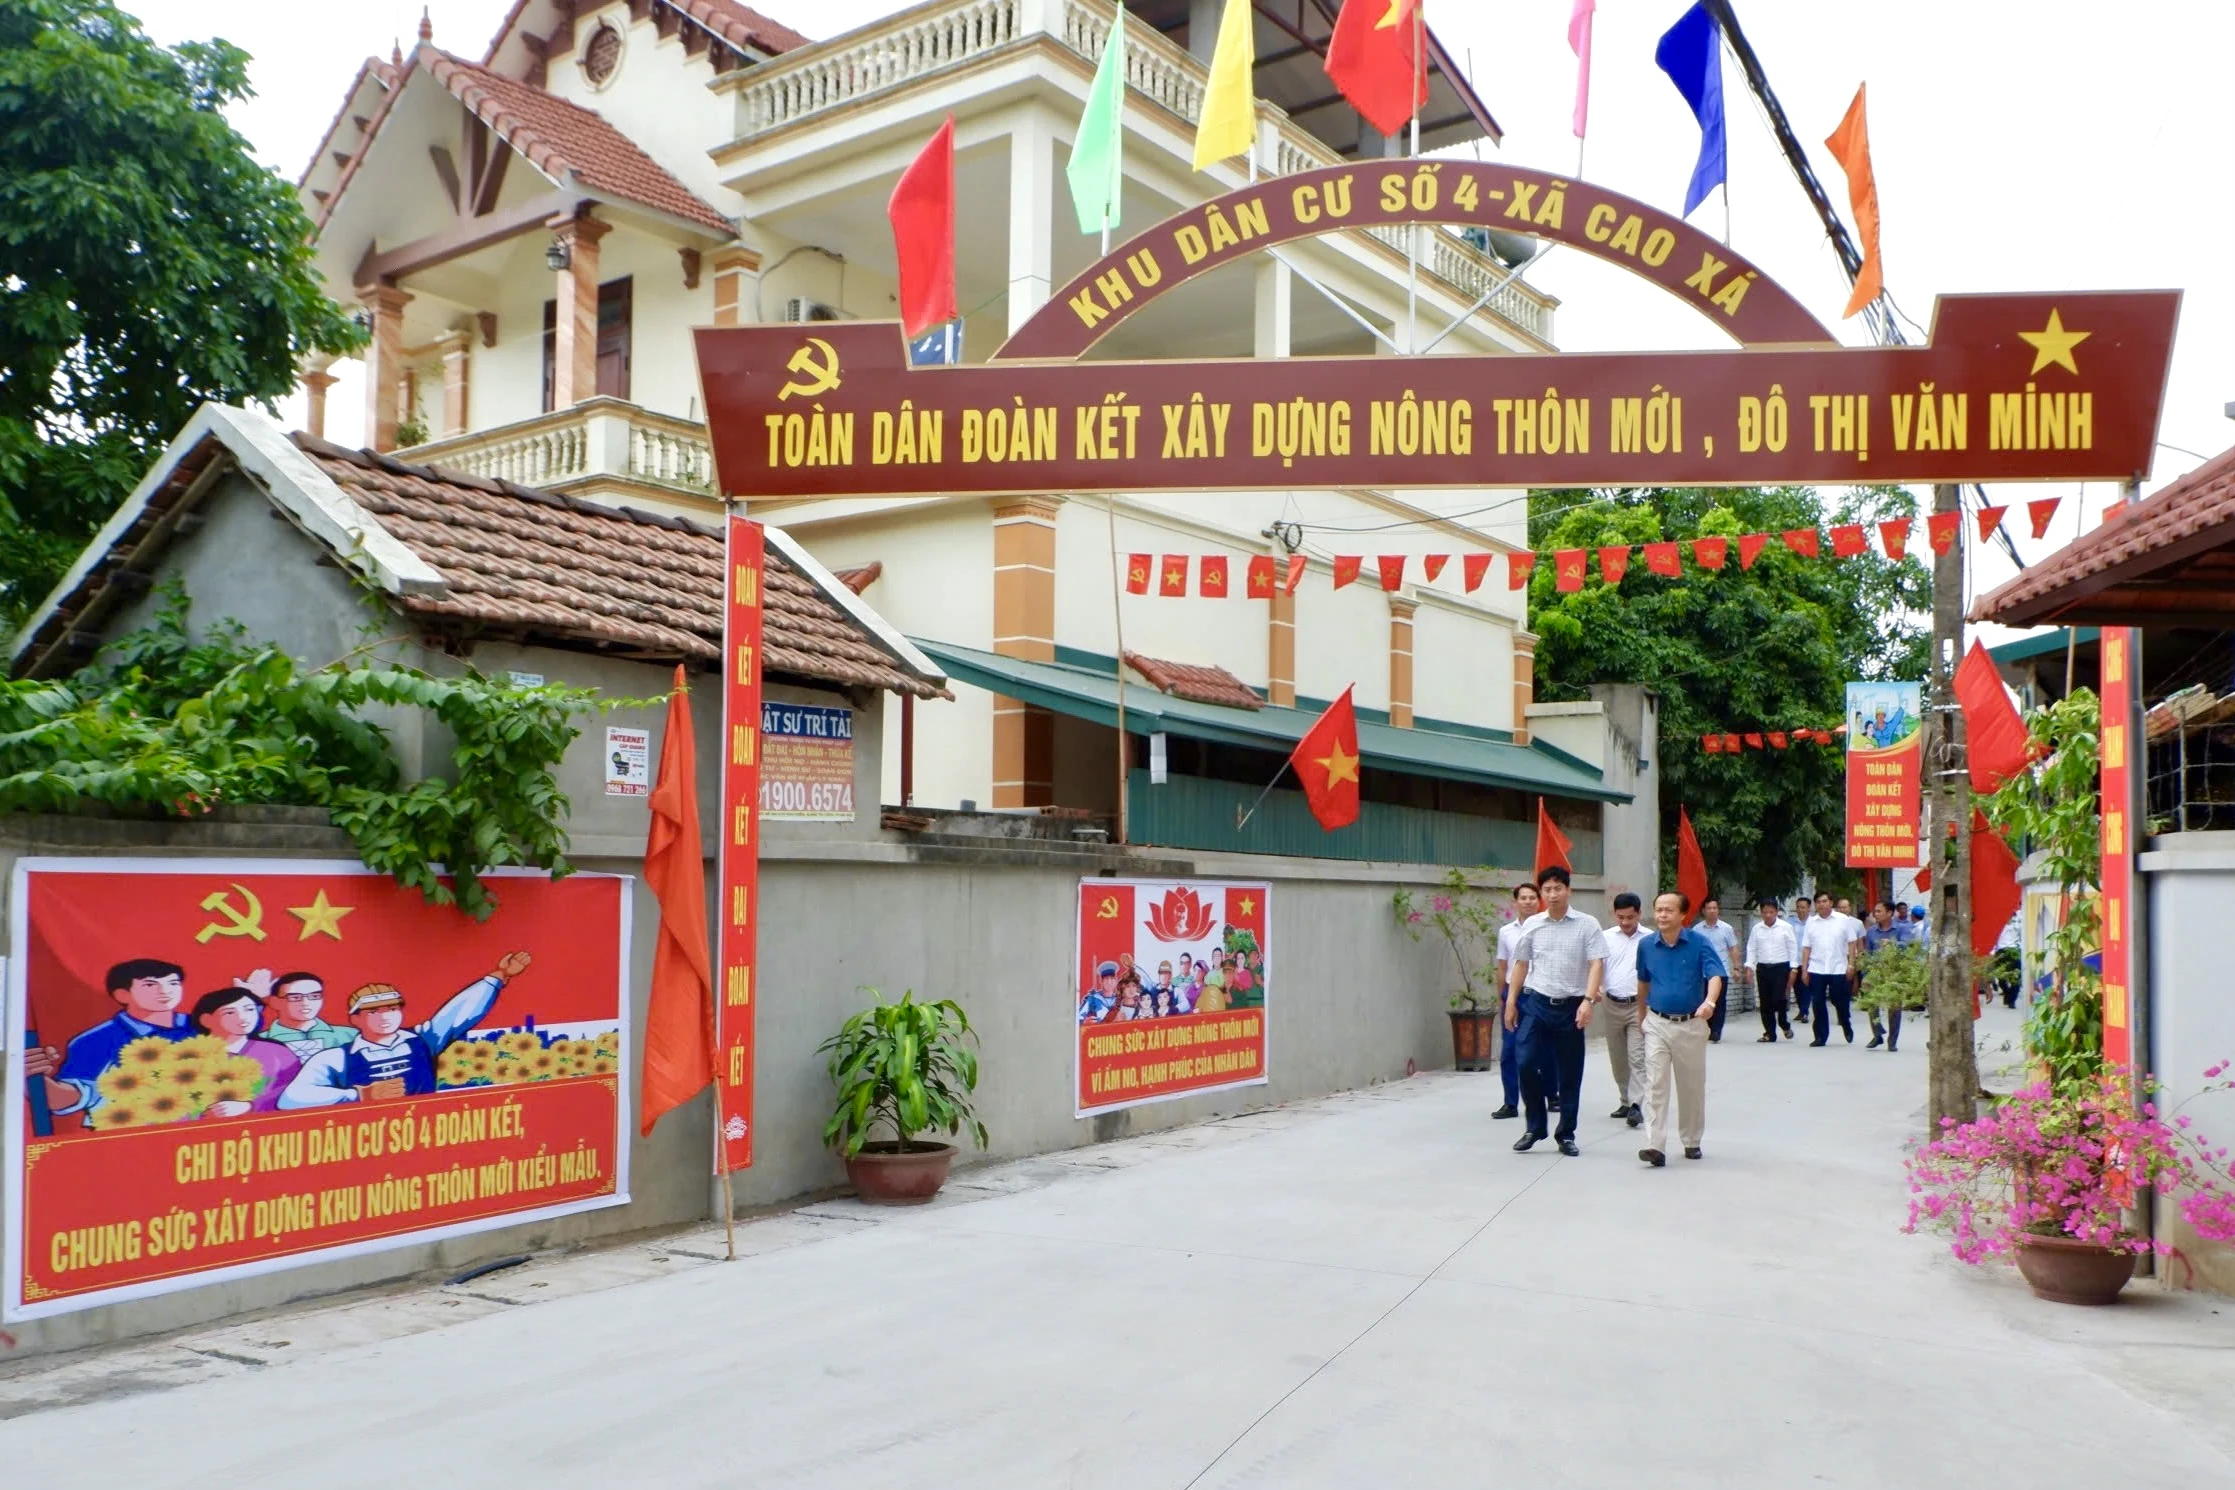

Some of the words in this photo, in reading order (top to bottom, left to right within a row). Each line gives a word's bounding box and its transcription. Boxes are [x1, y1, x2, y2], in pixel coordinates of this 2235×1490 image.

[1068, 248, 1162, 329] KHU
[1173, 198, 1271, 264] DÂN
[1291, 174, 1354, 224] CƯ
[1380, 163, 1442, 213] SỐ
[1584, 203, 1676, 267] CAO
[1684, 252, 1757, 316] XÁ
[765, 403, 854, 467] TOÀN
[873, 399, 943, 465] DÂN
[961, 395, 1057, 463] ĐOÀN
[1076, 391, 1141, 460] KẾT
[1161, 391, 1232, 459] XÂY
[1252, 396, 1351, 468] DỰNG
[1370, 389, 1472, 456] NÔNG
[1492, 387, 1590, 455] THÔN
[1737, 383, 1788, 453] ĐÔ
[1809, 394, 1869, 461] THỊ
[1891, 382, 1967, 451] VĂN
[735, 558, 758, 608] ĐOÀN
[737, 633, 754, 687] KẾT
[610, 734, 645, 743] INTERNET
[732, 716, 755, 766] ĐOÀN
[783, 710, 802, 734] SƯ
[804, 709, 827, 735] TRÍ
[830, 710, 852, 738] TÀI
[1865, 761, 1886, 776] TOÀN
[1887, 780, 1902, 796] KẾT
[734, 792, 750, 846] KẾT
[1853, 822, 1875, 837] NÔNG
[1876, 822, 1896, 837] THÔN
[733, 885, 749, 935] ĐẠI
[727, 957, 750, 1007] ĐOÀN
[729, 1032, 746, 1087] KẾT
[1087, 1034, 1123, 1059] CHUNG
[1125, 1028, 1145, 1053] SỨC
[1147, 1026, 1166, 1050] XÂY
[1167, 1026, 1193, 1052] DỰNG
[1194, 1022, 1219, 1044] NÔNG
[1220, 1018, 1242, 1041] THÔN
[1243, 1016, 1259, 1038] MỚI
[1091, 1066, 1102, 1094] VÌ
[1103, 1063, 1121, 1092] ẤM
[1140, 1063, 1168, 1089] HẠNH
[1169, 1055, 1194, 1081] PHÚC
[1195, 1050, 1213, 1076] CỦA
[1214, 1049, 1238, 1073] NHÂN
[1239, 1047, 1257, 1070] DÂN
[175, 1141, 217, 1184] CHI
[221, 1133, 254, 1185] BỘ
[258, 1131, 304, 1173] KHU
[307, 1119, 353, 1166] DÂN
[356, 1117, 388, 1159] CƯ
[388, 1102, 417, 1154] SỐ
[418, 1115, 432, 1149] 4
[434, 1104, 488, 1147] ĐOÀN
[489, 1094, 525, 1140] KẾT,
[50, 1220, 142, 1273] CHUNG
[147, 1208, 198, 1257] SỨC
[202, 1197, 249, 1247] XÂY
[253, 1193, 315, 1244] DỰNG
[319, 1185, 362, 1227] KHU
[366, 1173, 423, 1219] NÔNG
[425, 1163, 476, 1208] THÔN
[479, 1155, 514, 1198] MỚI
[517, 1149, 557, 1192] KIỂU
[559, 1146, 601, 1184] MẪU.
